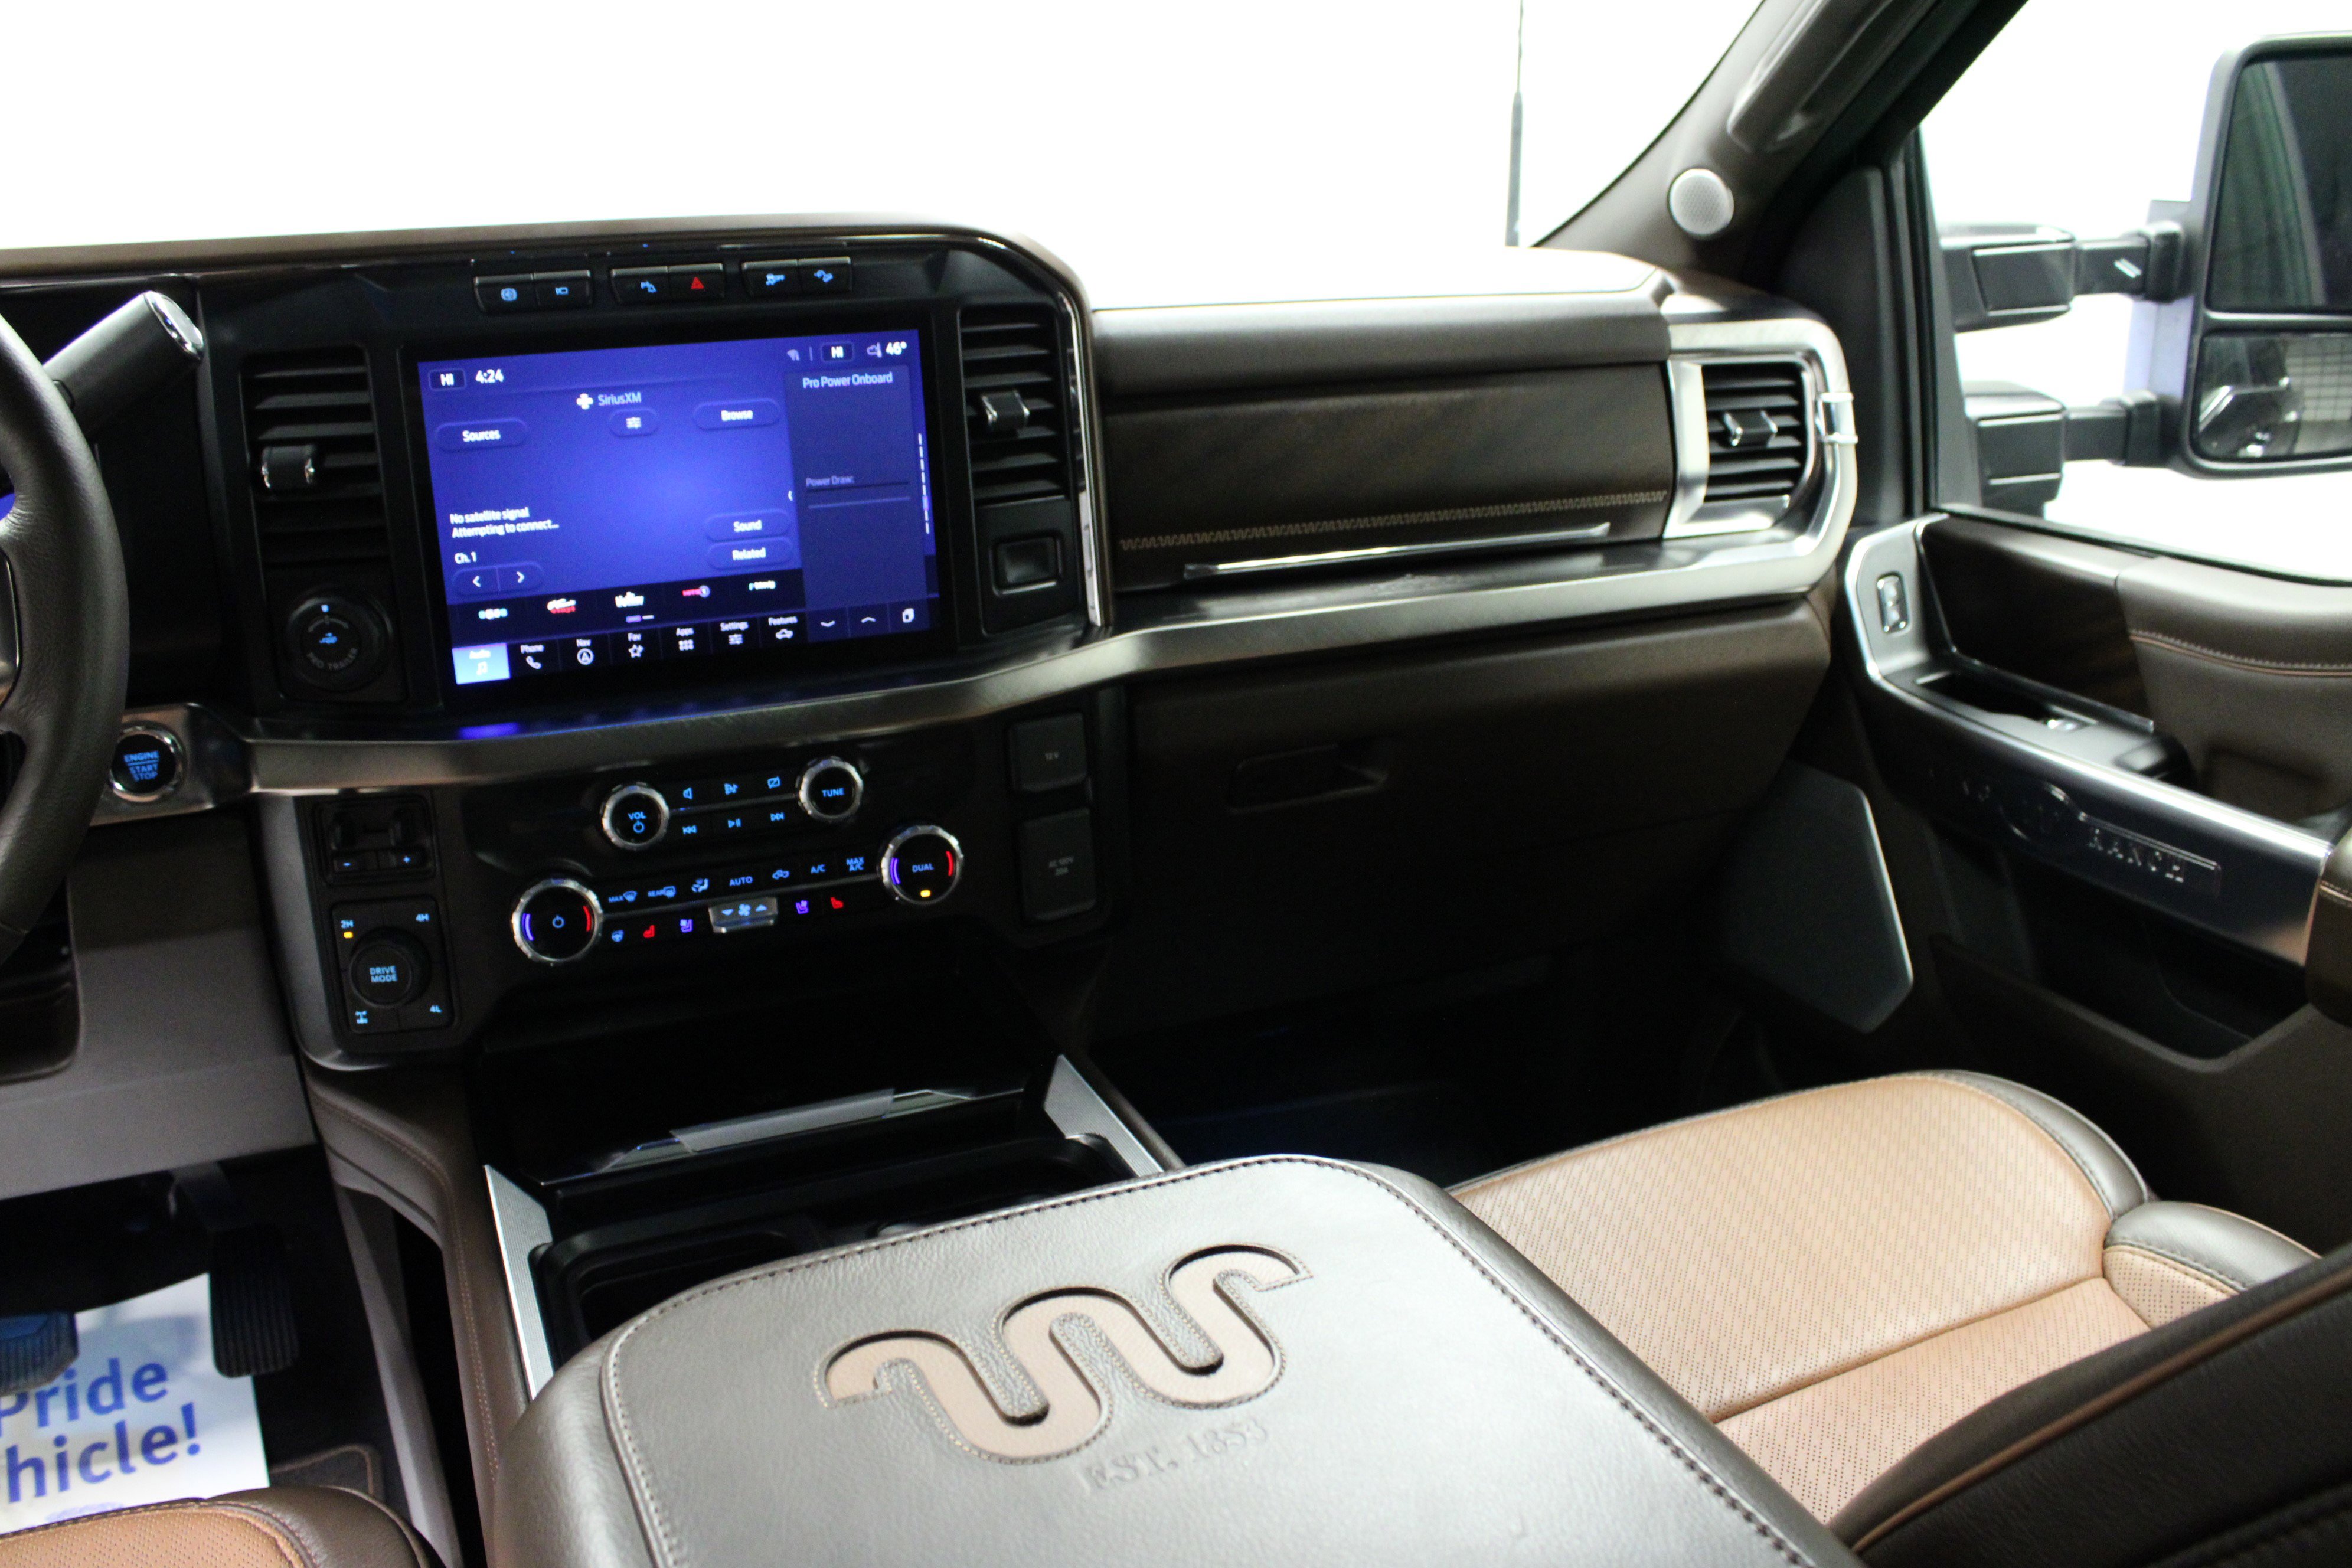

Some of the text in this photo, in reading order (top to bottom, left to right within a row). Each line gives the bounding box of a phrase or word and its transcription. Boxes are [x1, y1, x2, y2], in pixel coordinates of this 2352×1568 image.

[831, 346, 844, 358] HI
[440, 373, 454, 386] HI
[475, 369, 504, 384] 4:24
[802, 371, 893, 389] Pro Power Onboard
[598, 392, 642, 406] SiriusXM
[721, 410, 753, 421] Browse
[462, 430, 501, 442] Sources
[805, 476, 831, 487] Power
[450, 507, 530, 524] No satellite signal
[452, 524, 505, 538] Attempting
[505, 523, 516, 534] to
[733, 520, 762, 532] Sound
[732, 547, 766, 560] Related
[720, 622, 749, 631] Settings
[521, 644, 544, 654] Phone
[124, 750, 159, 763] ENGINE
[129, 763, 158, 774] START
[133, 770, 158, 782] STOP
[822, 788, 845, 798] TUNE
[628, 812, 646, 821] VOL
[847, 857, 865, 866] MAX
[811, 864, 826, 874] A/C
[849, 863, 864, 872] A/C
[912, 863, 934, 873] DUAL
[729, 876, 753, 887] AUTO
[416, 913, 430, 922] 4H
[341, 919, 354, 929] 2H
[370, 965, 396, 975] DRIVE
[371, 974, 398, 983] MODE
[429, 1005, 442, 1014] 4L
